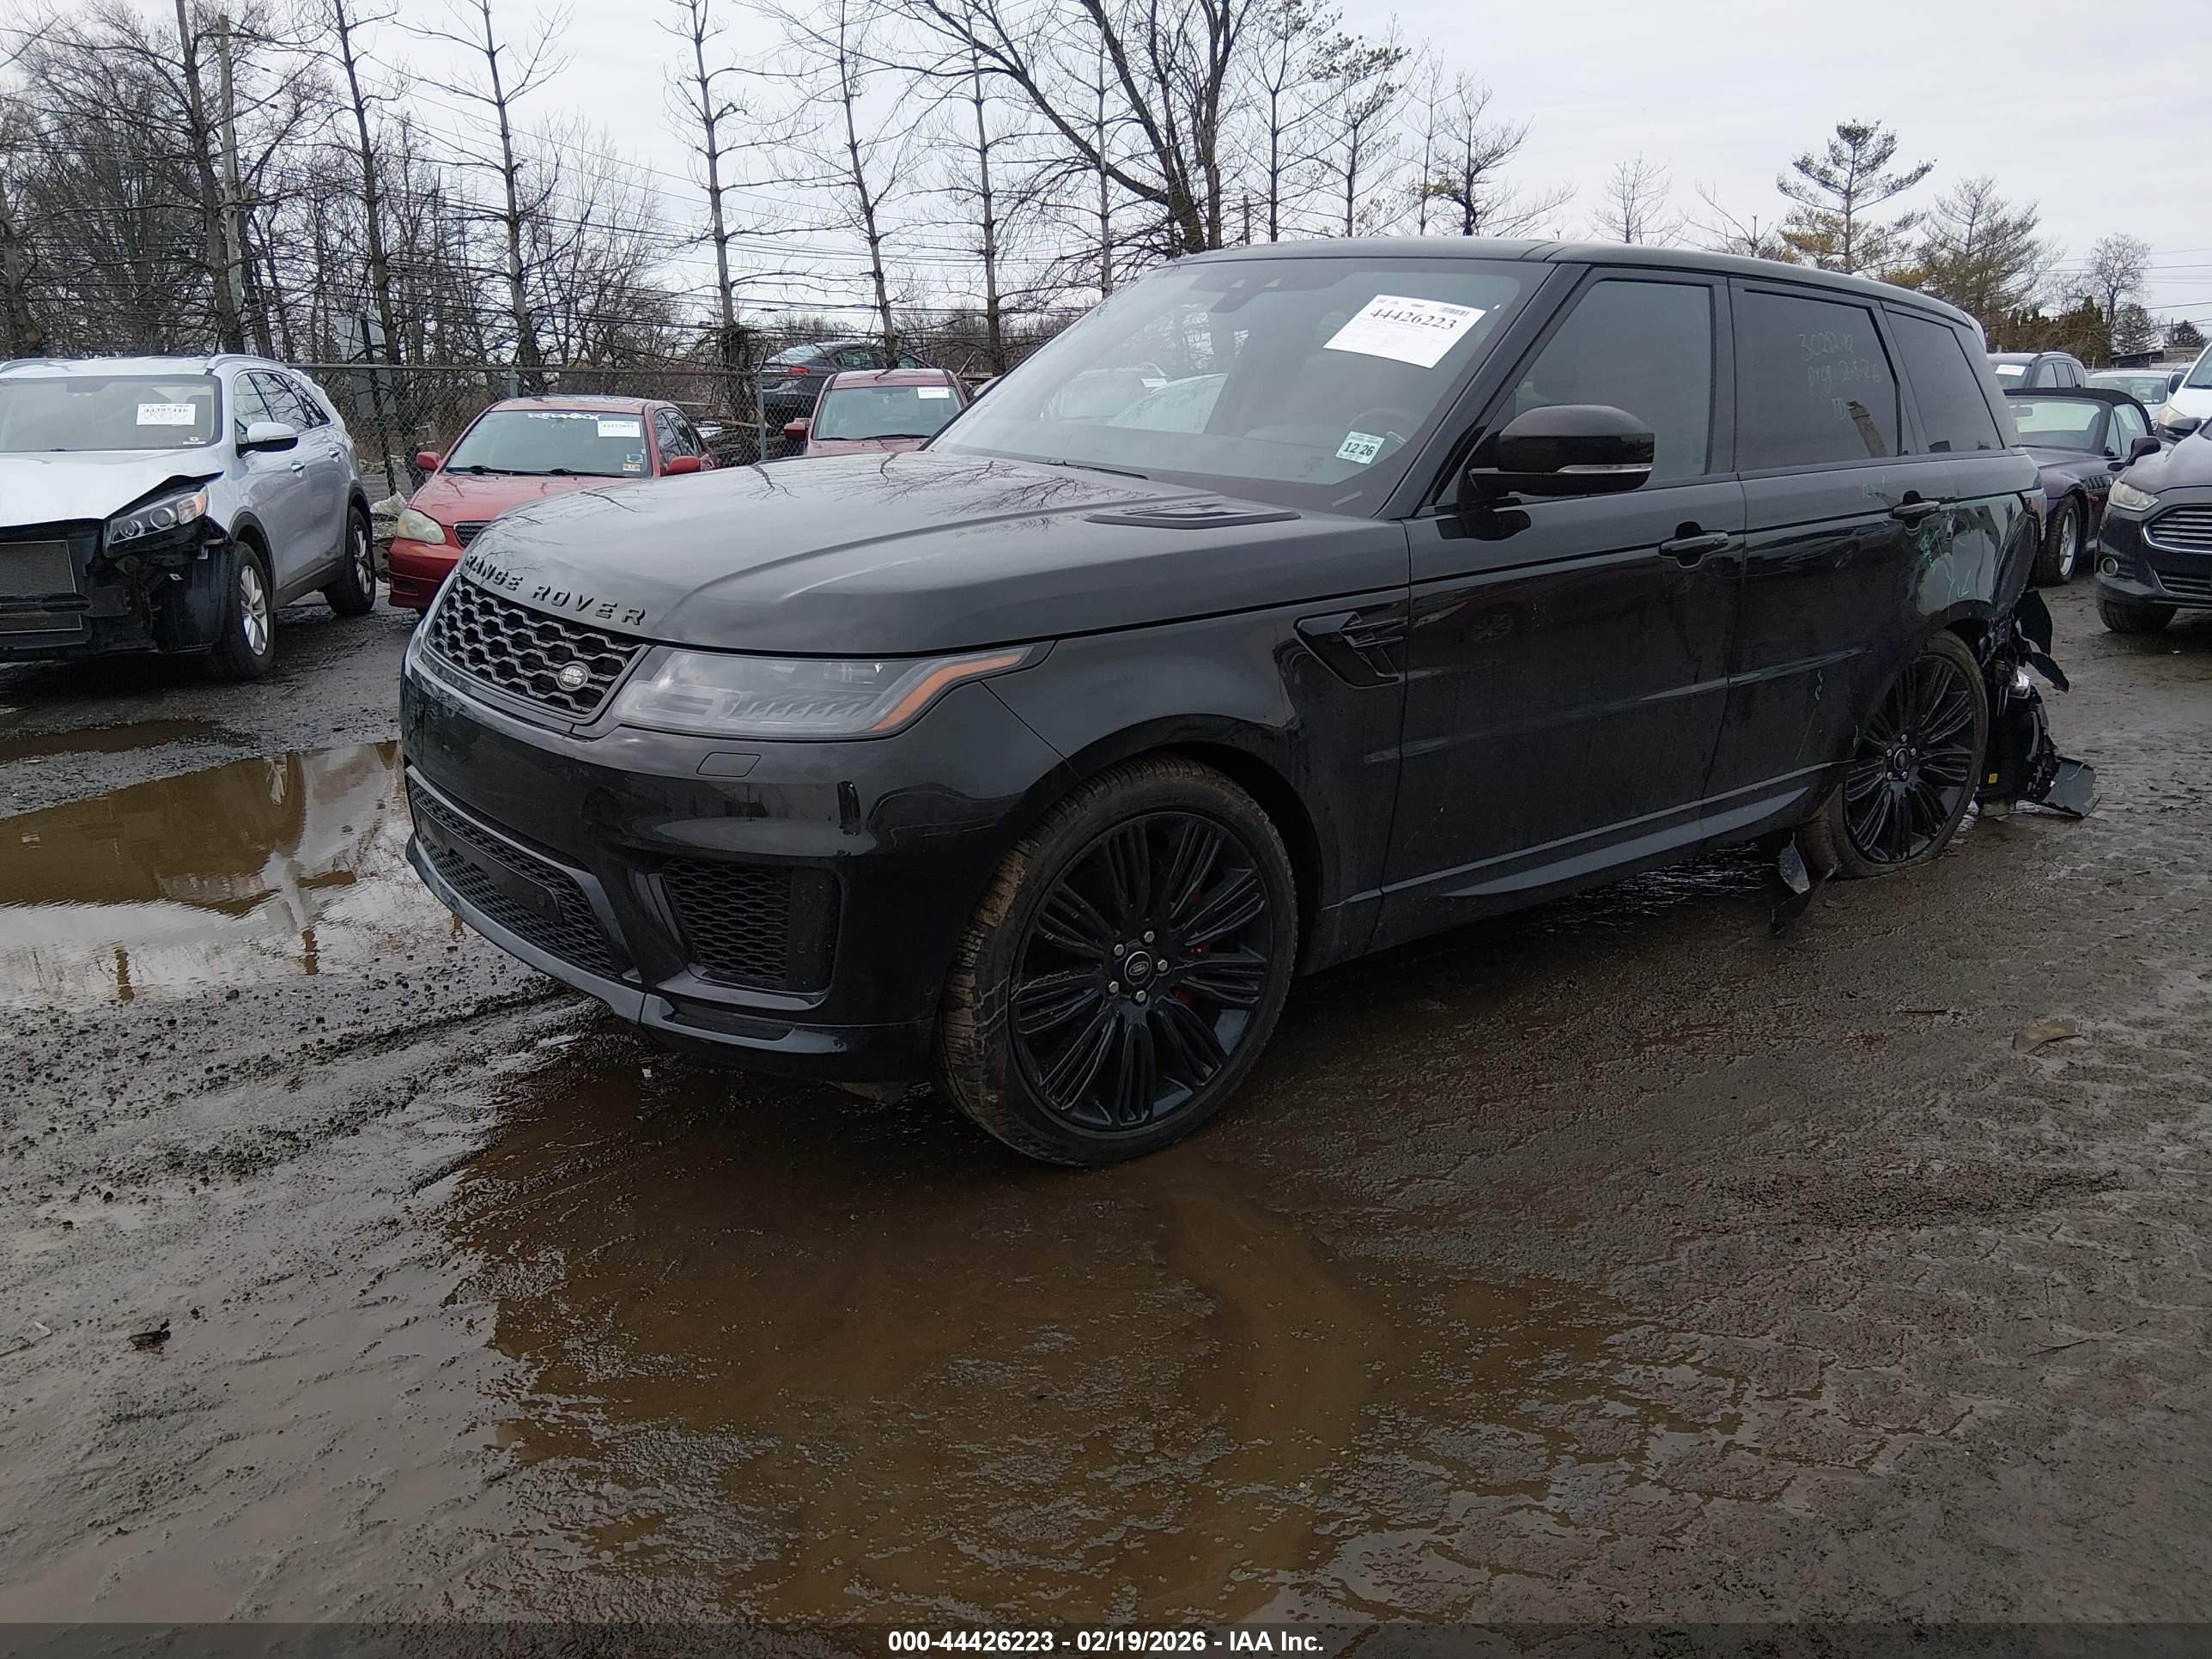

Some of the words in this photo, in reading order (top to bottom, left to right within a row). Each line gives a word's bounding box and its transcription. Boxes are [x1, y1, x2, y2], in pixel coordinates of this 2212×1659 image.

[1369, 308, 1458, 331] 44426223
[465, 556, 524, 592] RANGE
[531, 585, 647, 626] ROVER
